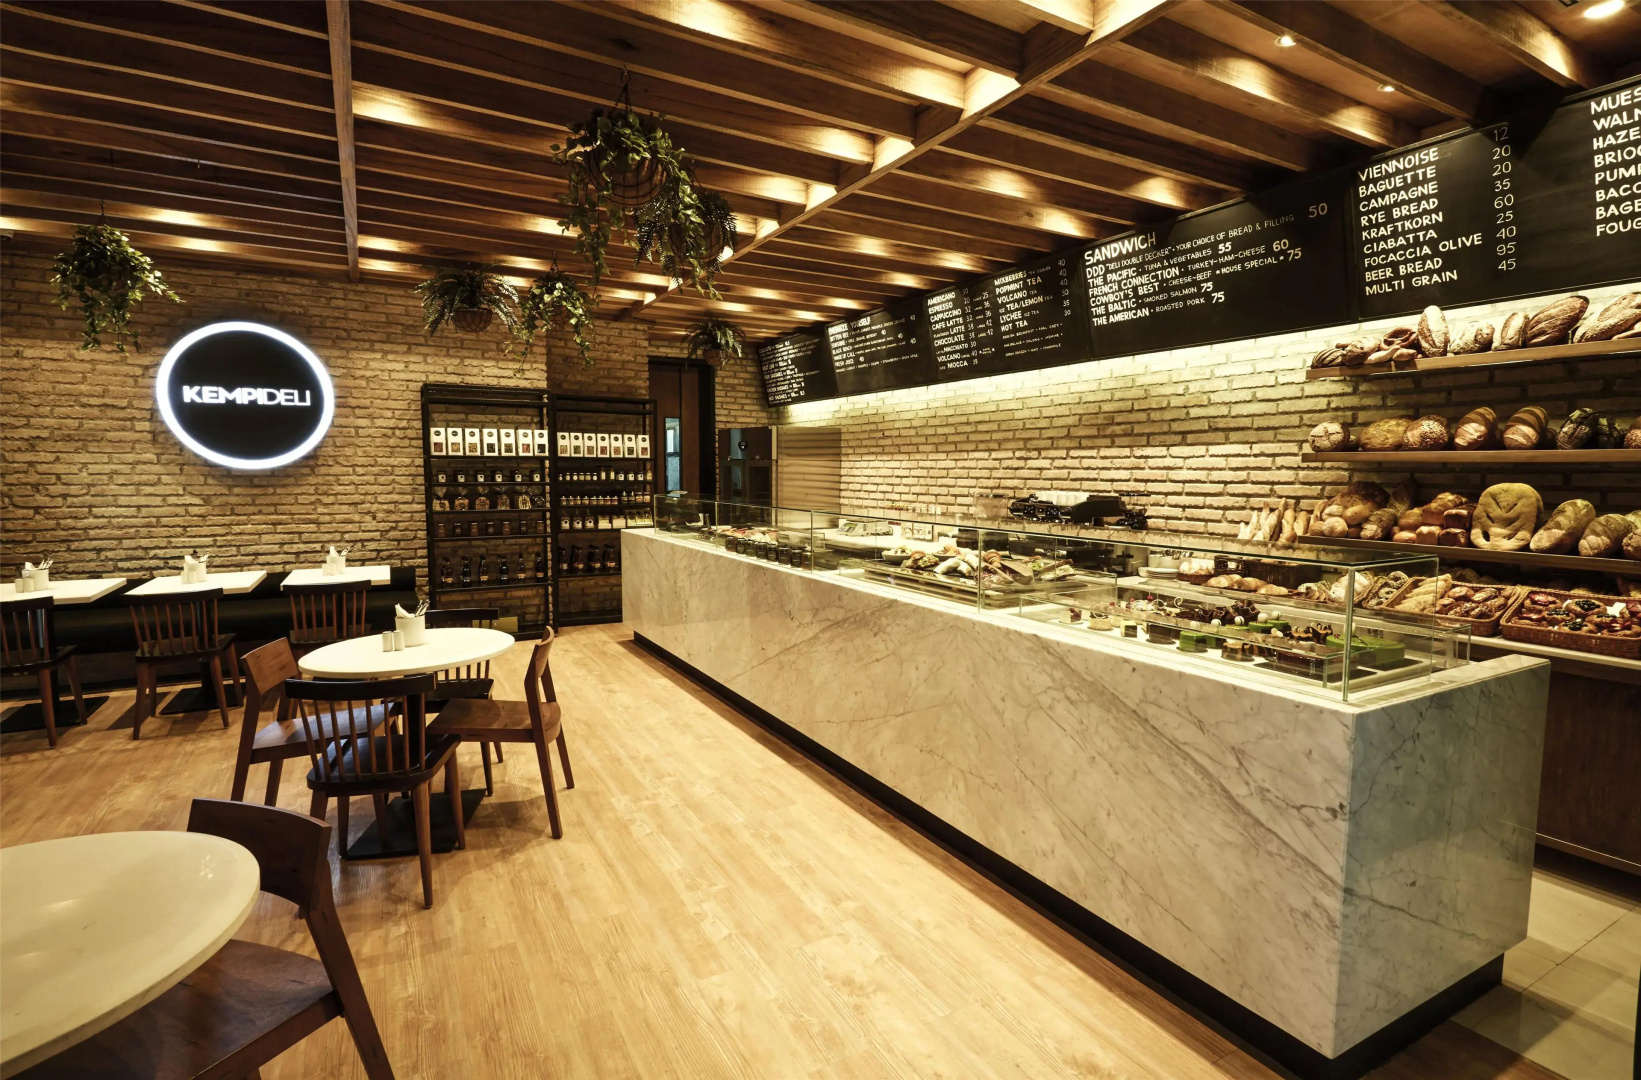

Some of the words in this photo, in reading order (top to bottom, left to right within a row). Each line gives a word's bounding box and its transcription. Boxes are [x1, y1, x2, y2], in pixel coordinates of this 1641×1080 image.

[1358, 148, 1439, 182] VIENNOISE
[1494, 126, 1509, 142] 12
[1593, 126, 1640, 150] HAZE
[1358, 166, 1436, 198] BAGUETTE
[1492, 144, 1511, 160] 20
[1359, 181, 1438, 212] CAMPAGNE
[1492, 162, 1512, 176] 20
[1360, 211, 1386, 227] RYE
[1392, 198, 1439, 219] BREAD
[1494, 178, 1511, 192] 35
[1362, 212, 1444, 241] KRAFTKORN
[1494, 194, 1514, 209] 60
[1084, 232, 1156, 266] SANDWICH
[1086, 264, 1105, 278] DDD
[1122, 254, 1144, 266] DOUBLE
[1176, 241, 1192, 252] YOUR
[1192, 234, 1215, 248] CHOICE
[1216, 232, 1226, 240] OF
[1228, 224, 1252, 238] BREAD
[1256, 222, 1261, 230] &
[1264, 214, 1294, 228] FILLING
[1308, 202, 1328, 218] 50
[1363, 229, 1438, 254] CIABATTA
[1496, 210, 1514, 224] 25
[1364, 245, 1432, 268] FOCACCIA
[1438, 232, 1482, 252] OLIVE
[1496, 226, 1516, 240] 40
[1088, 276, 1104, 288] THE
[1106, 268, 1137, 283] PACIFIC
[1144, 262, 1162, 272] TUNA
[1170, 248, 1212, 264] VEGETABLES
[1218, 242, 1232, 254] 55
[1088, 284, 1118, 298] FRENCH
[1121, 266, 1180, 290] CONNECTION
[1272, 239, 1289, 252] 60
[1090, 288, 1134, 306] COWBOY'S
[1138, 282, 1160, 296] BEST
[1222, 264, 1242, 274] HOUSE
[1244, 256, 1278, 270] SPECIAL
[1287, 248, 1302, 262] 75
[1365, 267, 1394, 282] BEER
[1399, 257, 1443, 276] BREAD
[1496, 242, 1517, 256] 95
[1365, 280, 1405, 296] MULTI
[1412, 269, 1458, 288] GRAIN
[1498, 258, 1517, 272] 45
[928, 292, 956, 306] AMERICANO
[996, 280, 1024, 295] POPMINT
[1026, 276, 1042, 286] TEA
[997, 290, 1028, 304] VOLCANO
[1091, 306, 1106, 316] THE
[1108, 298, 1137, 312] BALTIC
[1143, 292, 1168, 304] SMOKED
[1170, 286, 1198, 298] SALMON
[1200, 282, 1214, 293] 75
[928, 302, 954, 314] ESPRESSO
[930, 308, 962, 322] CAPPUCCINO
[1000, 310, 1022, 324] LYCHEE
[1006, 295, 1044, 311] TEA/LEMON
[1092, 316, 1108, 326] THE
[1108, 307, 1150, 324] AMERICAN
[1156, 302, 1184, 312] ROASTED
[1187, 298, 1206, 307] PORK
[1212, 292, 1225, 304] 75
[932, 322, 946, 330] CAFE
[946, 316, 964, 327] LATTE
[934, 334, 964, 346] CHOCOLATE
[950, 325, 965, 334] LATTE
[1000, 323, 1012, 332] HOT
[1015, 320, 1028, 328] TEA
[937, 352, 960, 362] VOLCANO
[182, 386, 310, 406] KEMPIDELI
